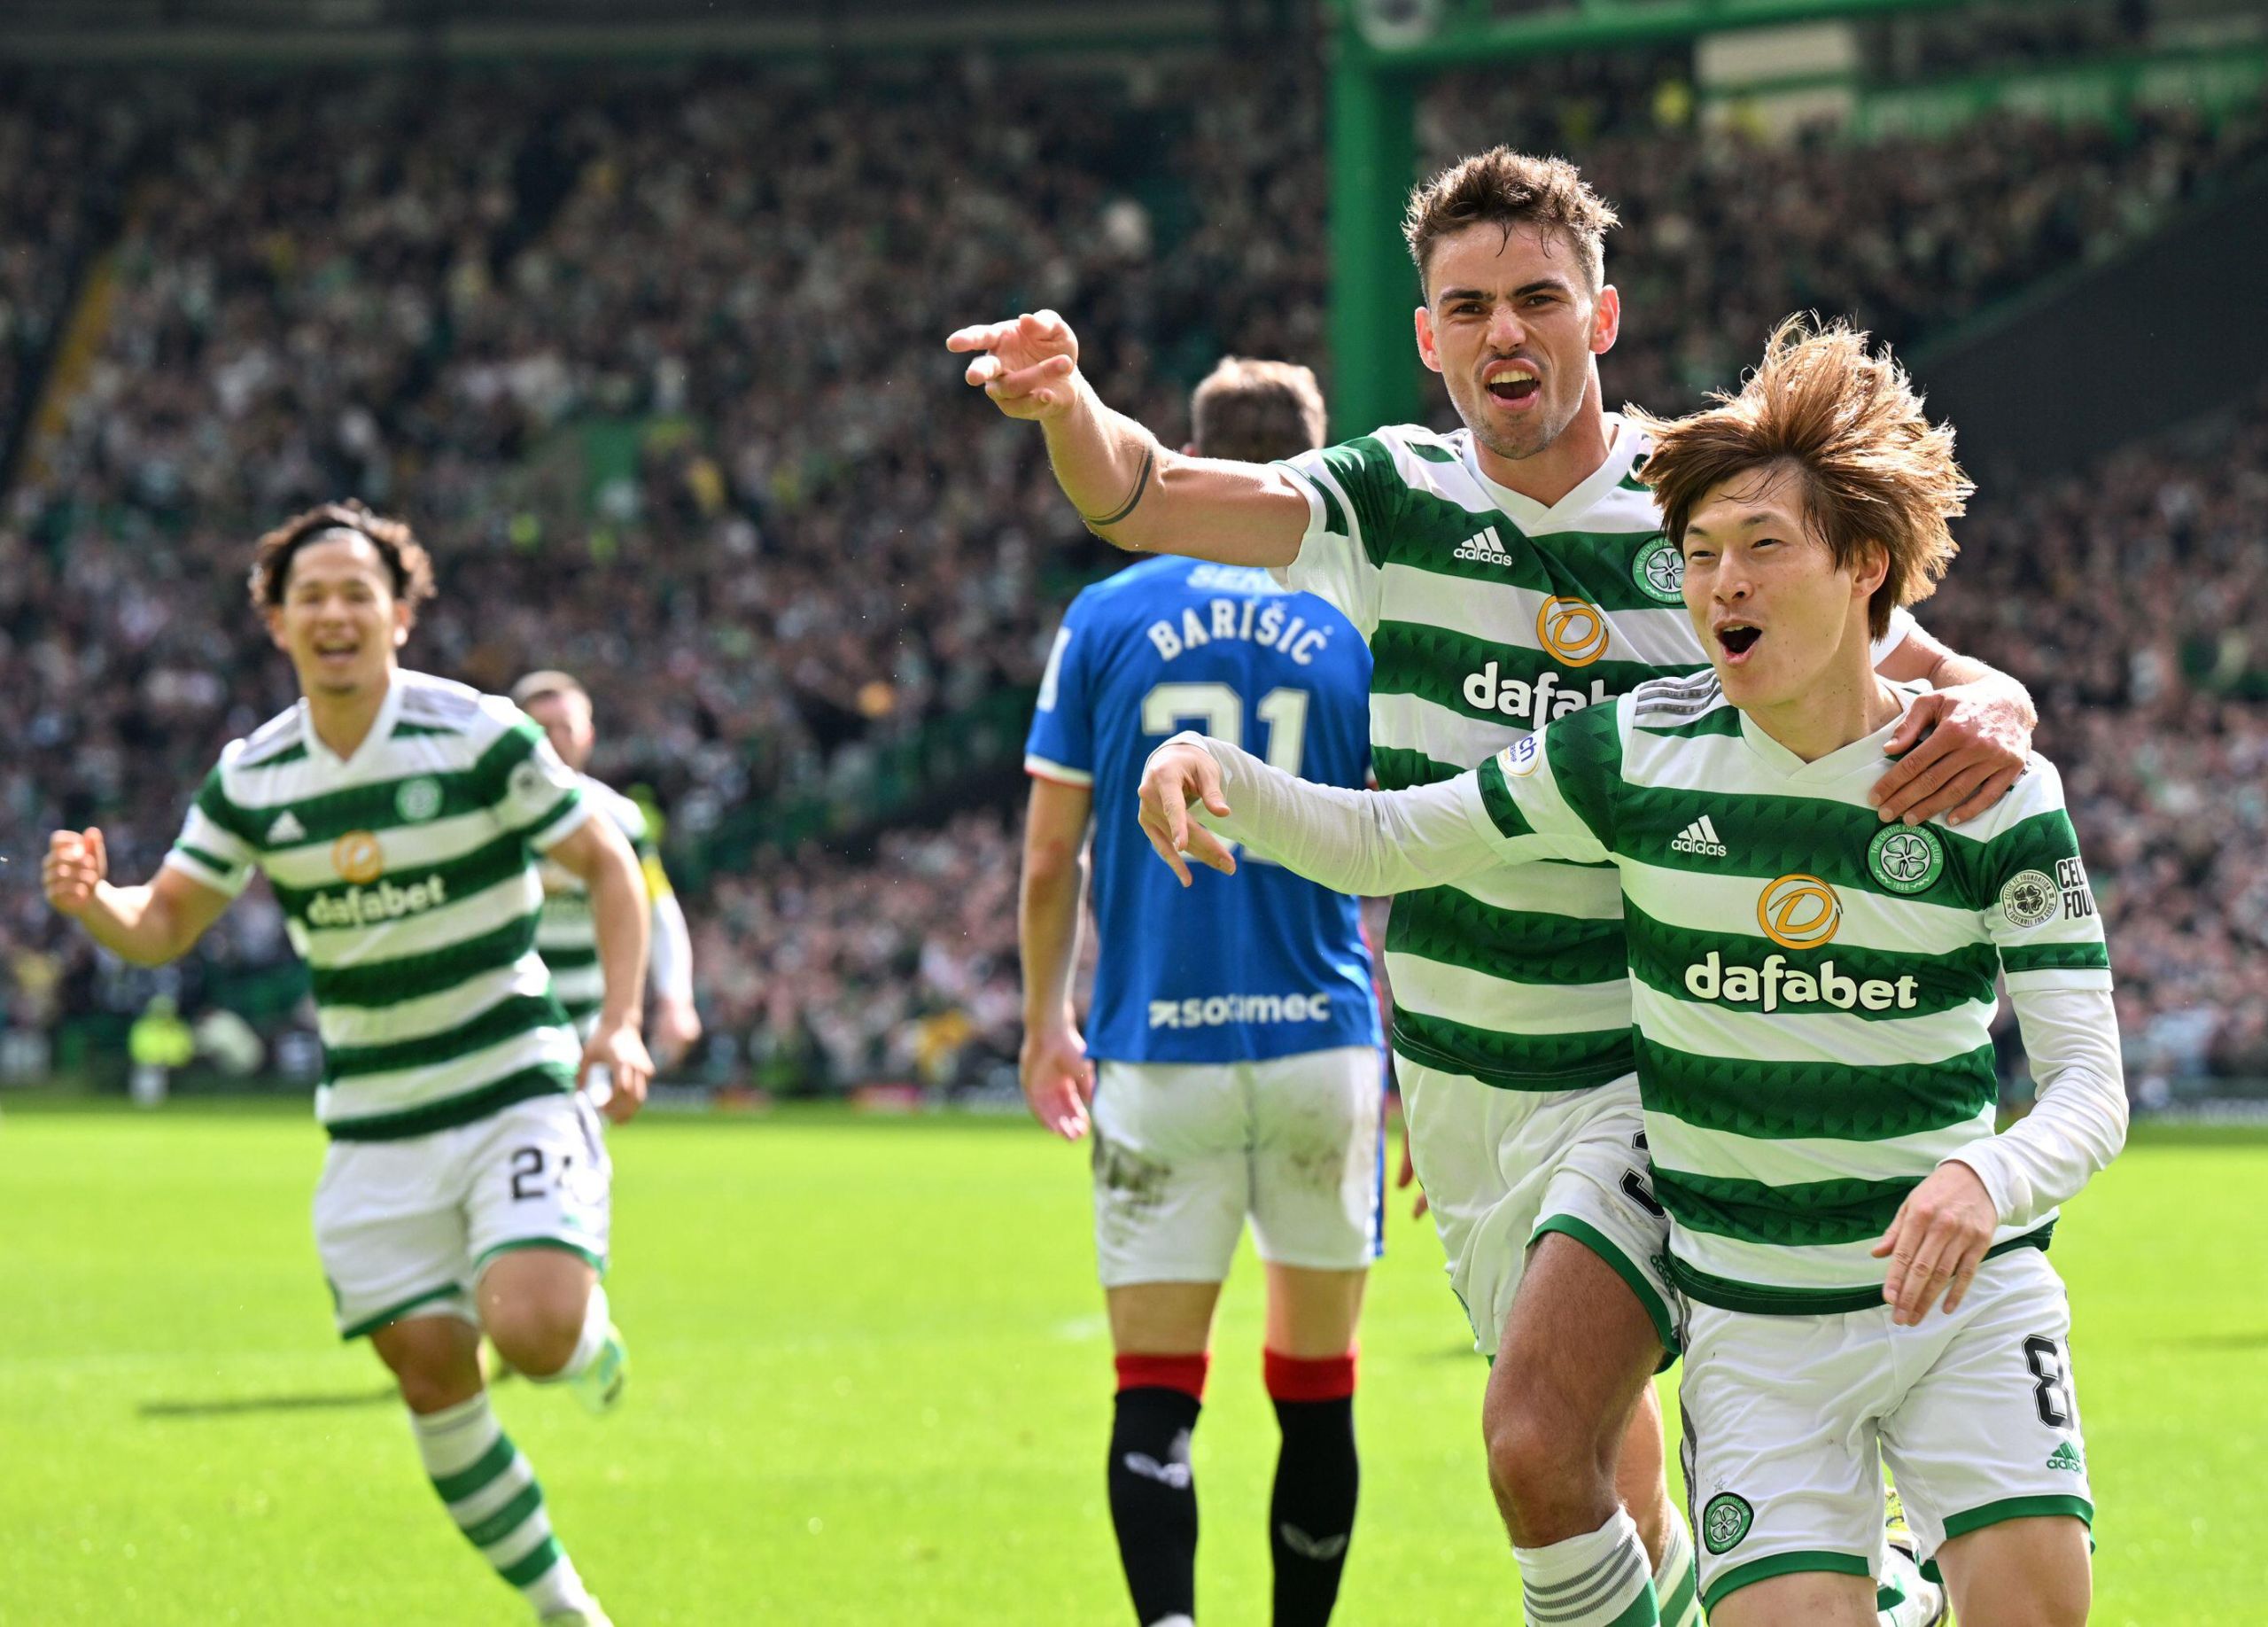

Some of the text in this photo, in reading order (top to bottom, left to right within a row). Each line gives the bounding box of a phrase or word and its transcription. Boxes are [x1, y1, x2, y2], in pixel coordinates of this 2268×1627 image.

[1453, 547, 1513, 567] adidas
[1639, 541, 1659, 559] CELTIC
[1671, 837, 1727, 857] adidas
[1871, 825, 1941, 864] THE CELTIC FOOTBALL CLUB
[2056, 858, 2086, 890] CEL
[1685, 951, 1919, 1012] dafabet
[2022, 1334, 2075, 1431] 8
